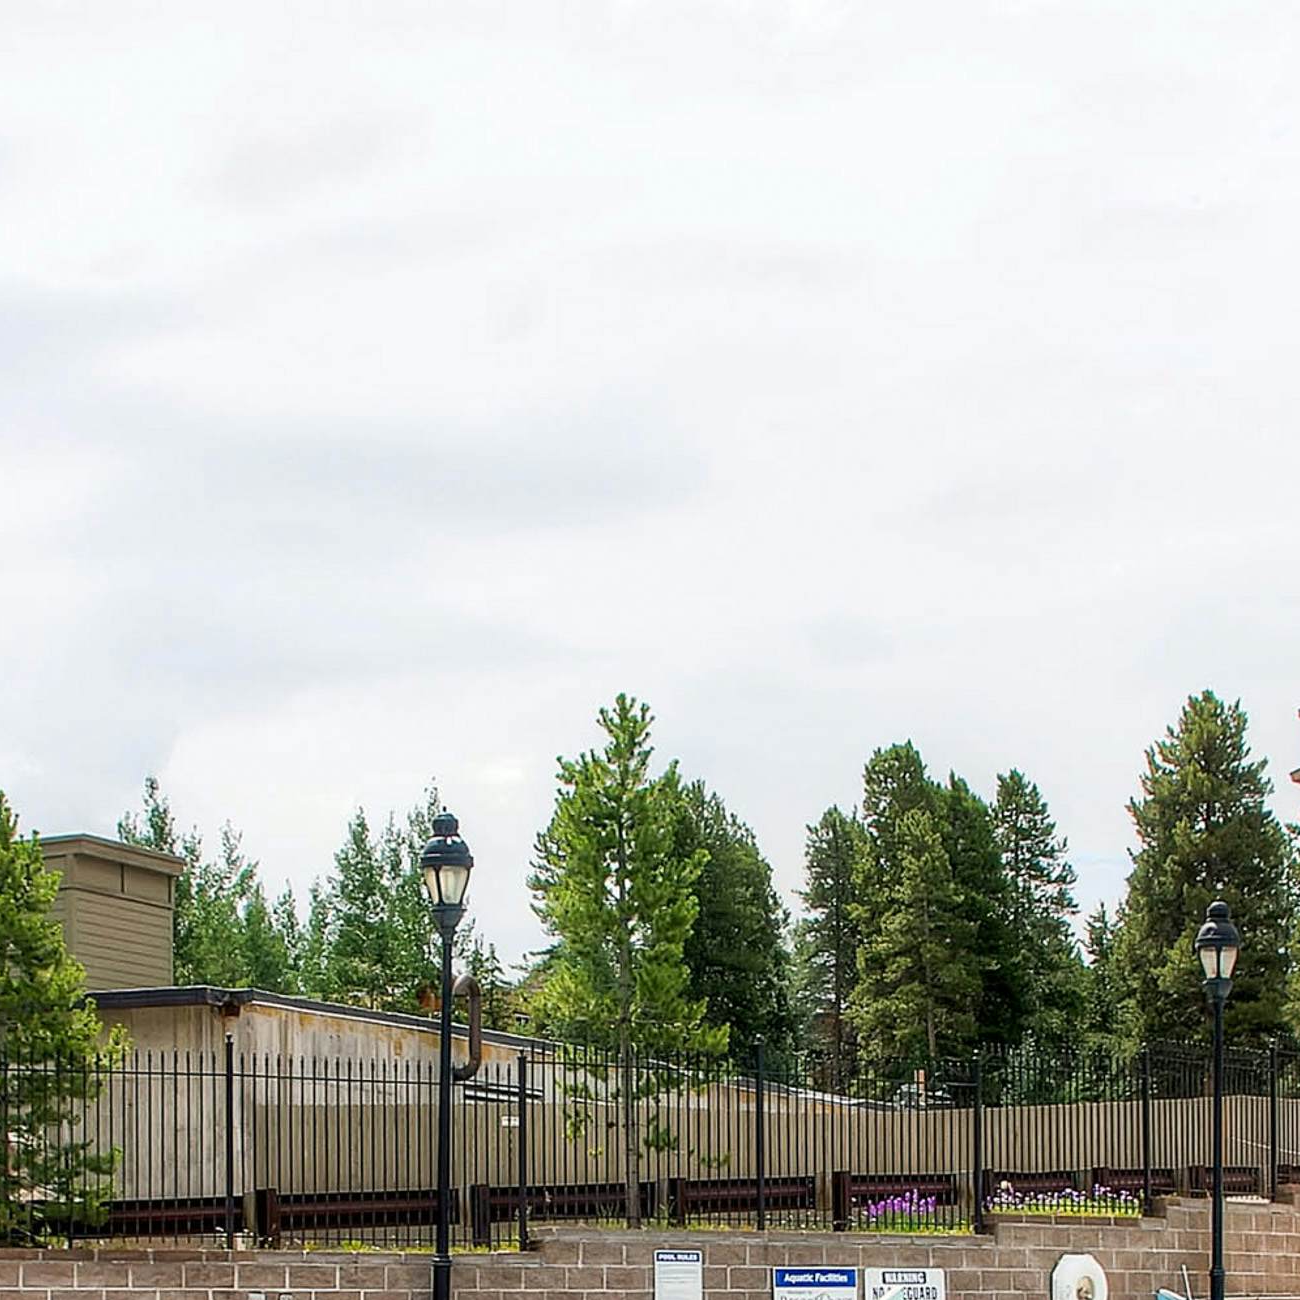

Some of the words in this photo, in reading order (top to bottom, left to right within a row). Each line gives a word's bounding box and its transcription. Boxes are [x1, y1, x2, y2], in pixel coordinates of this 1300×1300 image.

[783, 1273, 814, 1284] Aquatic
[815, 1272, 848, 1283] Facilities
[884, 1273, 925, 1283] WARNING
